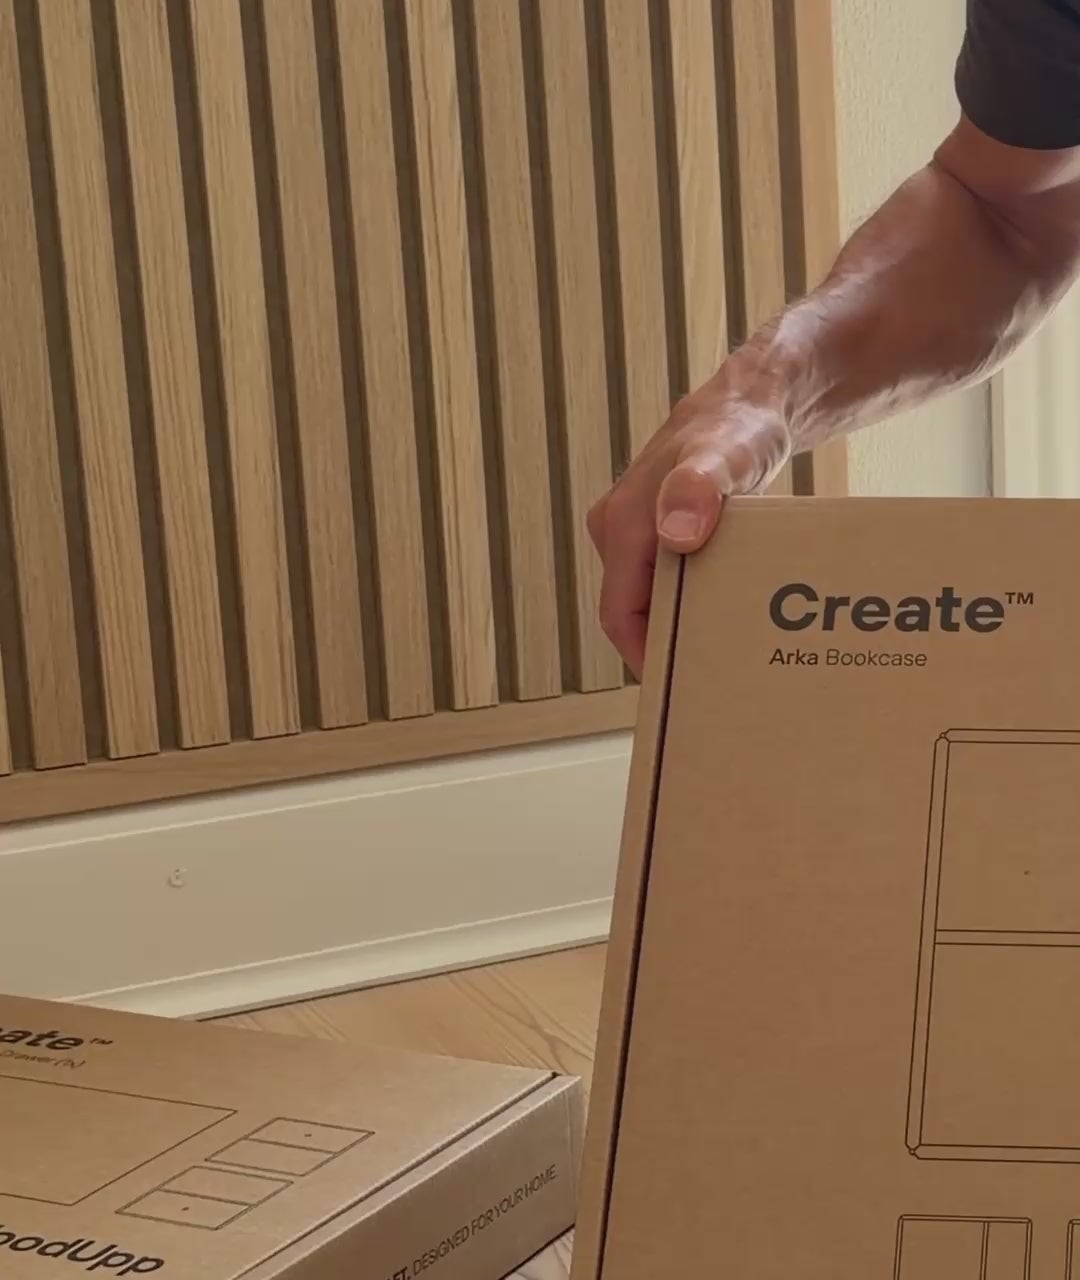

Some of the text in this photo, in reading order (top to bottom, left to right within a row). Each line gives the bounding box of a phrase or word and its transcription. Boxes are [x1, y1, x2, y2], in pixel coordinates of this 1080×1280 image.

[769, 648, 928, 667] Arka Bookcase
[0, 1029, 113, 1051] ate™
[413, 1225, 470, 1276] DESIGNED
[471, 1209, 493, 1236] FOR
[494, 1187, 524, 1218] YOUR
